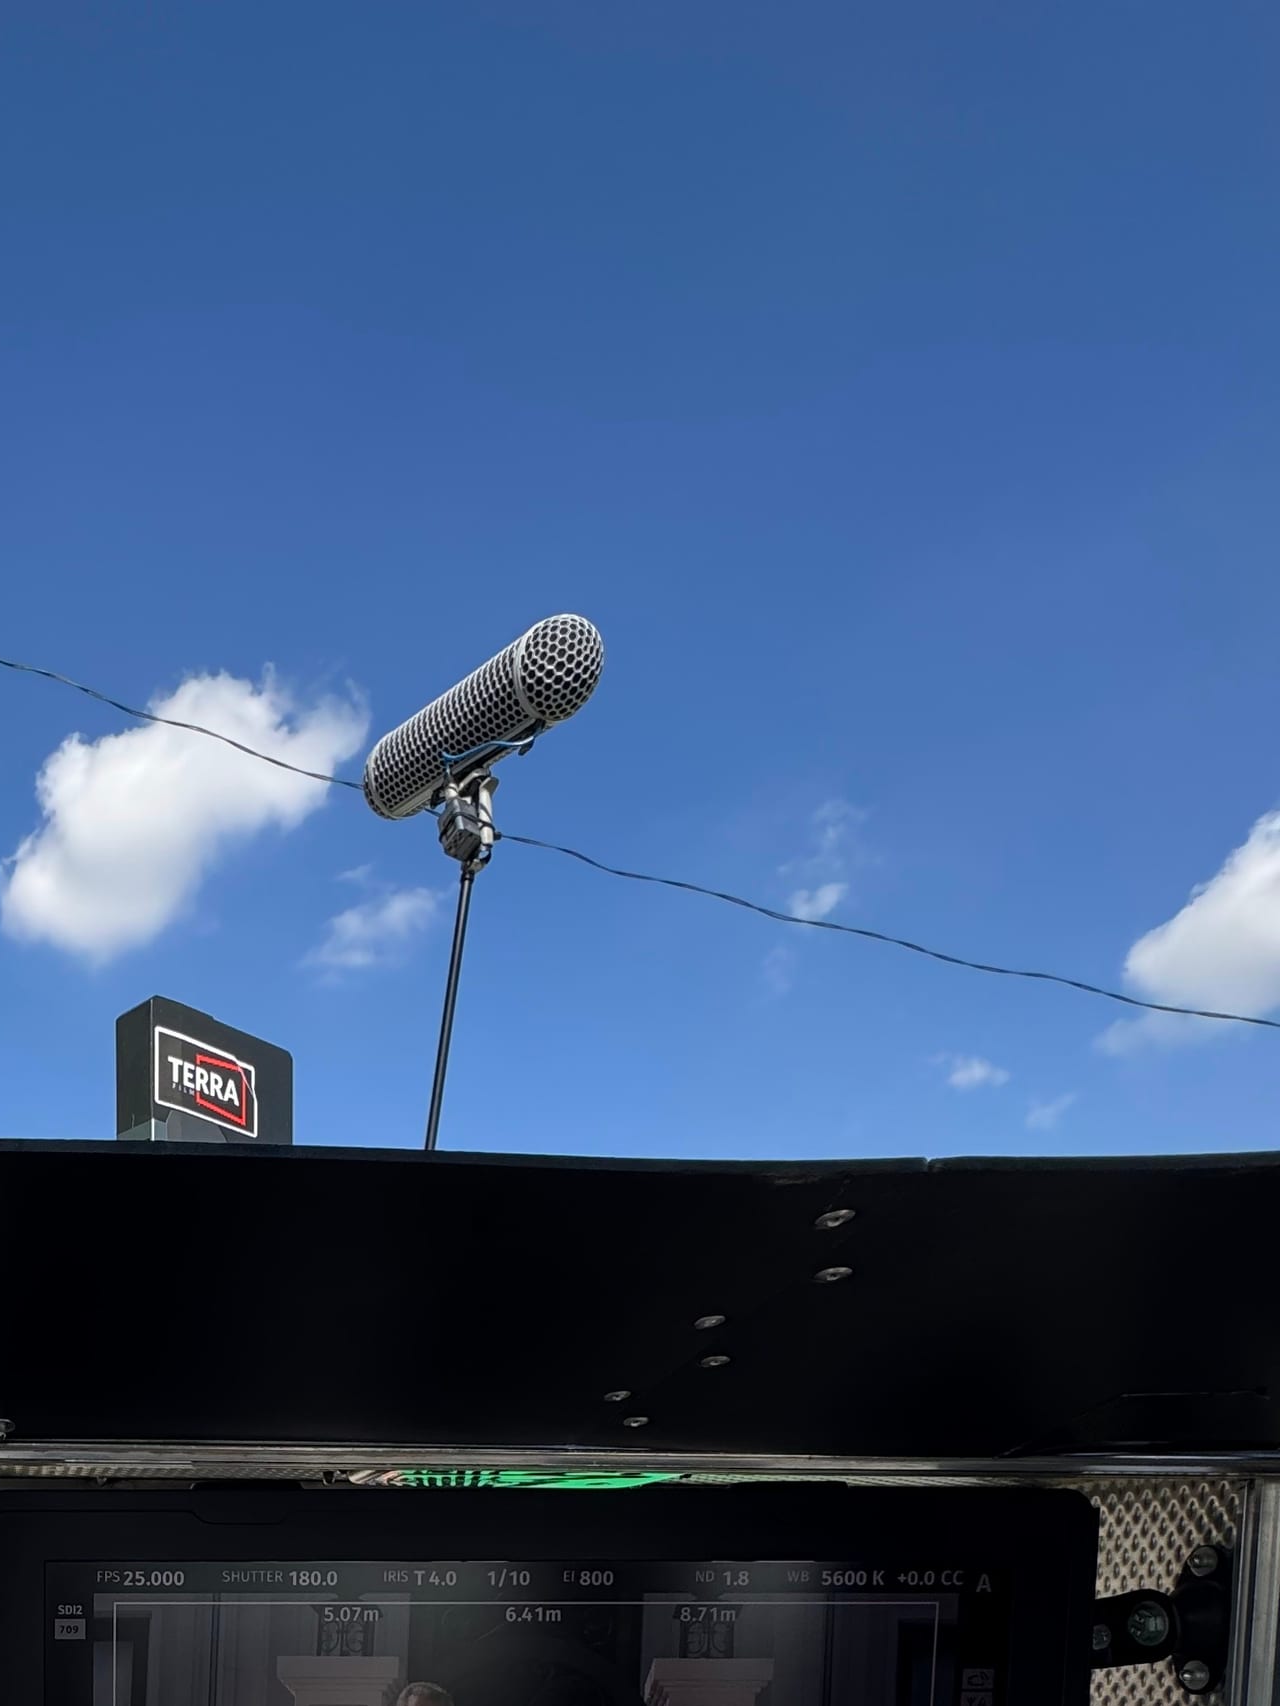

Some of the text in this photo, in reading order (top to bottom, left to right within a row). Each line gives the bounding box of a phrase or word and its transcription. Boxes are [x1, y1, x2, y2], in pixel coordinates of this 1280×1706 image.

[167, 1054, 240, 1107] TERRA
[96, 1570, 121, 1583] FPS
[123, 1570, 185, 1586] 25.000
[222, 1570, 283, 1583] SHUTTER
[288, 1570, 338, 1586] 180.0
[383, 1570, 409, 1583] IRIS
[487, 1568, 531, 1588] 1/10
[579, 1570, 614, 1586] 800
[695, 1570, 715, 1583] ND
[722, 1570, 750, 1587] 1.8
[786, 1570, 810, 1584] WB
[821, 1570, 867, 1586] 5600
[872, 1570, 885, 1586] K
[897, 1570, 936, 1586] +0.0
[940, 1570, 964, 1586] CC
[975, 1573, 992, 1593] A
[57, 1604, 83, 1616] SDI2
[323, 1606, 379, 1623] 5.07m
[505, 1606, 562, 1623] 6.41m
[680, 1606, 736, 1623] 8.71m
[59, 1624, 79, 1635] 709
